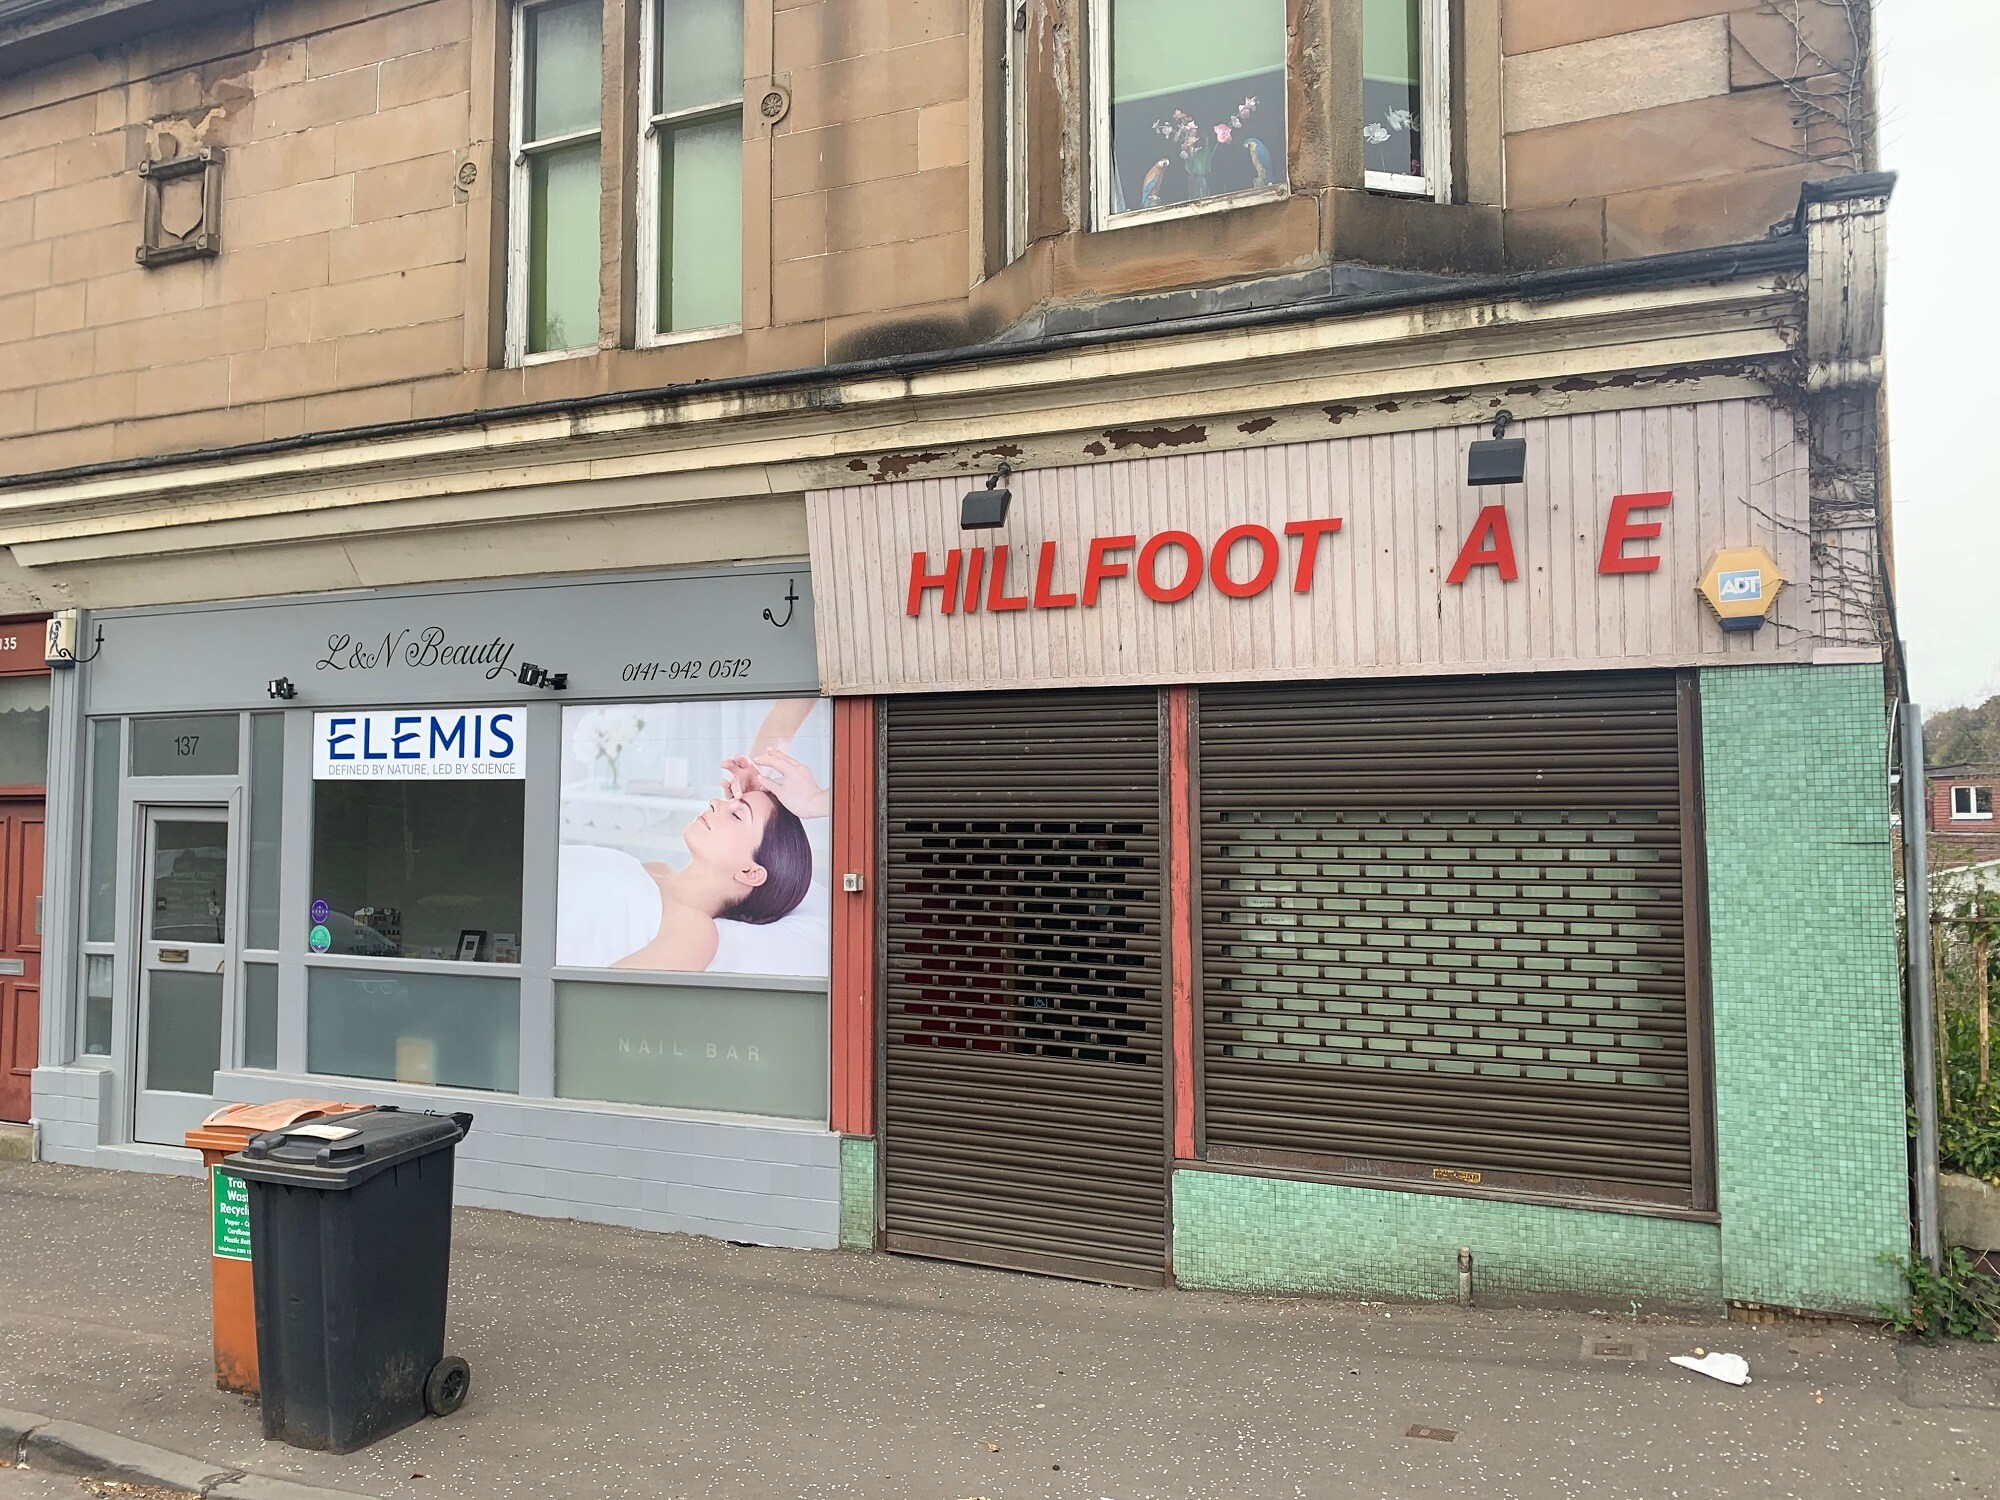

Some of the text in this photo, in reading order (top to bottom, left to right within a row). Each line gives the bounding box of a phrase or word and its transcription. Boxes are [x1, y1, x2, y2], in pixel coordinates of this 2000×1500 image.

[906, 491, 1673, 618] HILLFOOT A E
[1720, 575, 1761, 595] ADT
[315, 626, 518, 680] L&N Beauty
[622, 658, 752, 682] 0141-942 0512
[174, 735, 200, 756] 137
[326, 713, 514, 760] ELEMIS
[328, 762, 516, 776] DEFINED BY NATURE, LED BY SCIENCE
[618, 1037, 760, 1061] NAIL BAR
[227, 1177, 247, 1190] Tra
[227, 1190, 249, 1203] Wast
[220, 1202, 250, 1217] Recycli
[224, 1218, 240, 1227] Paper
[223, 1235, 240, 1245] Plastic
